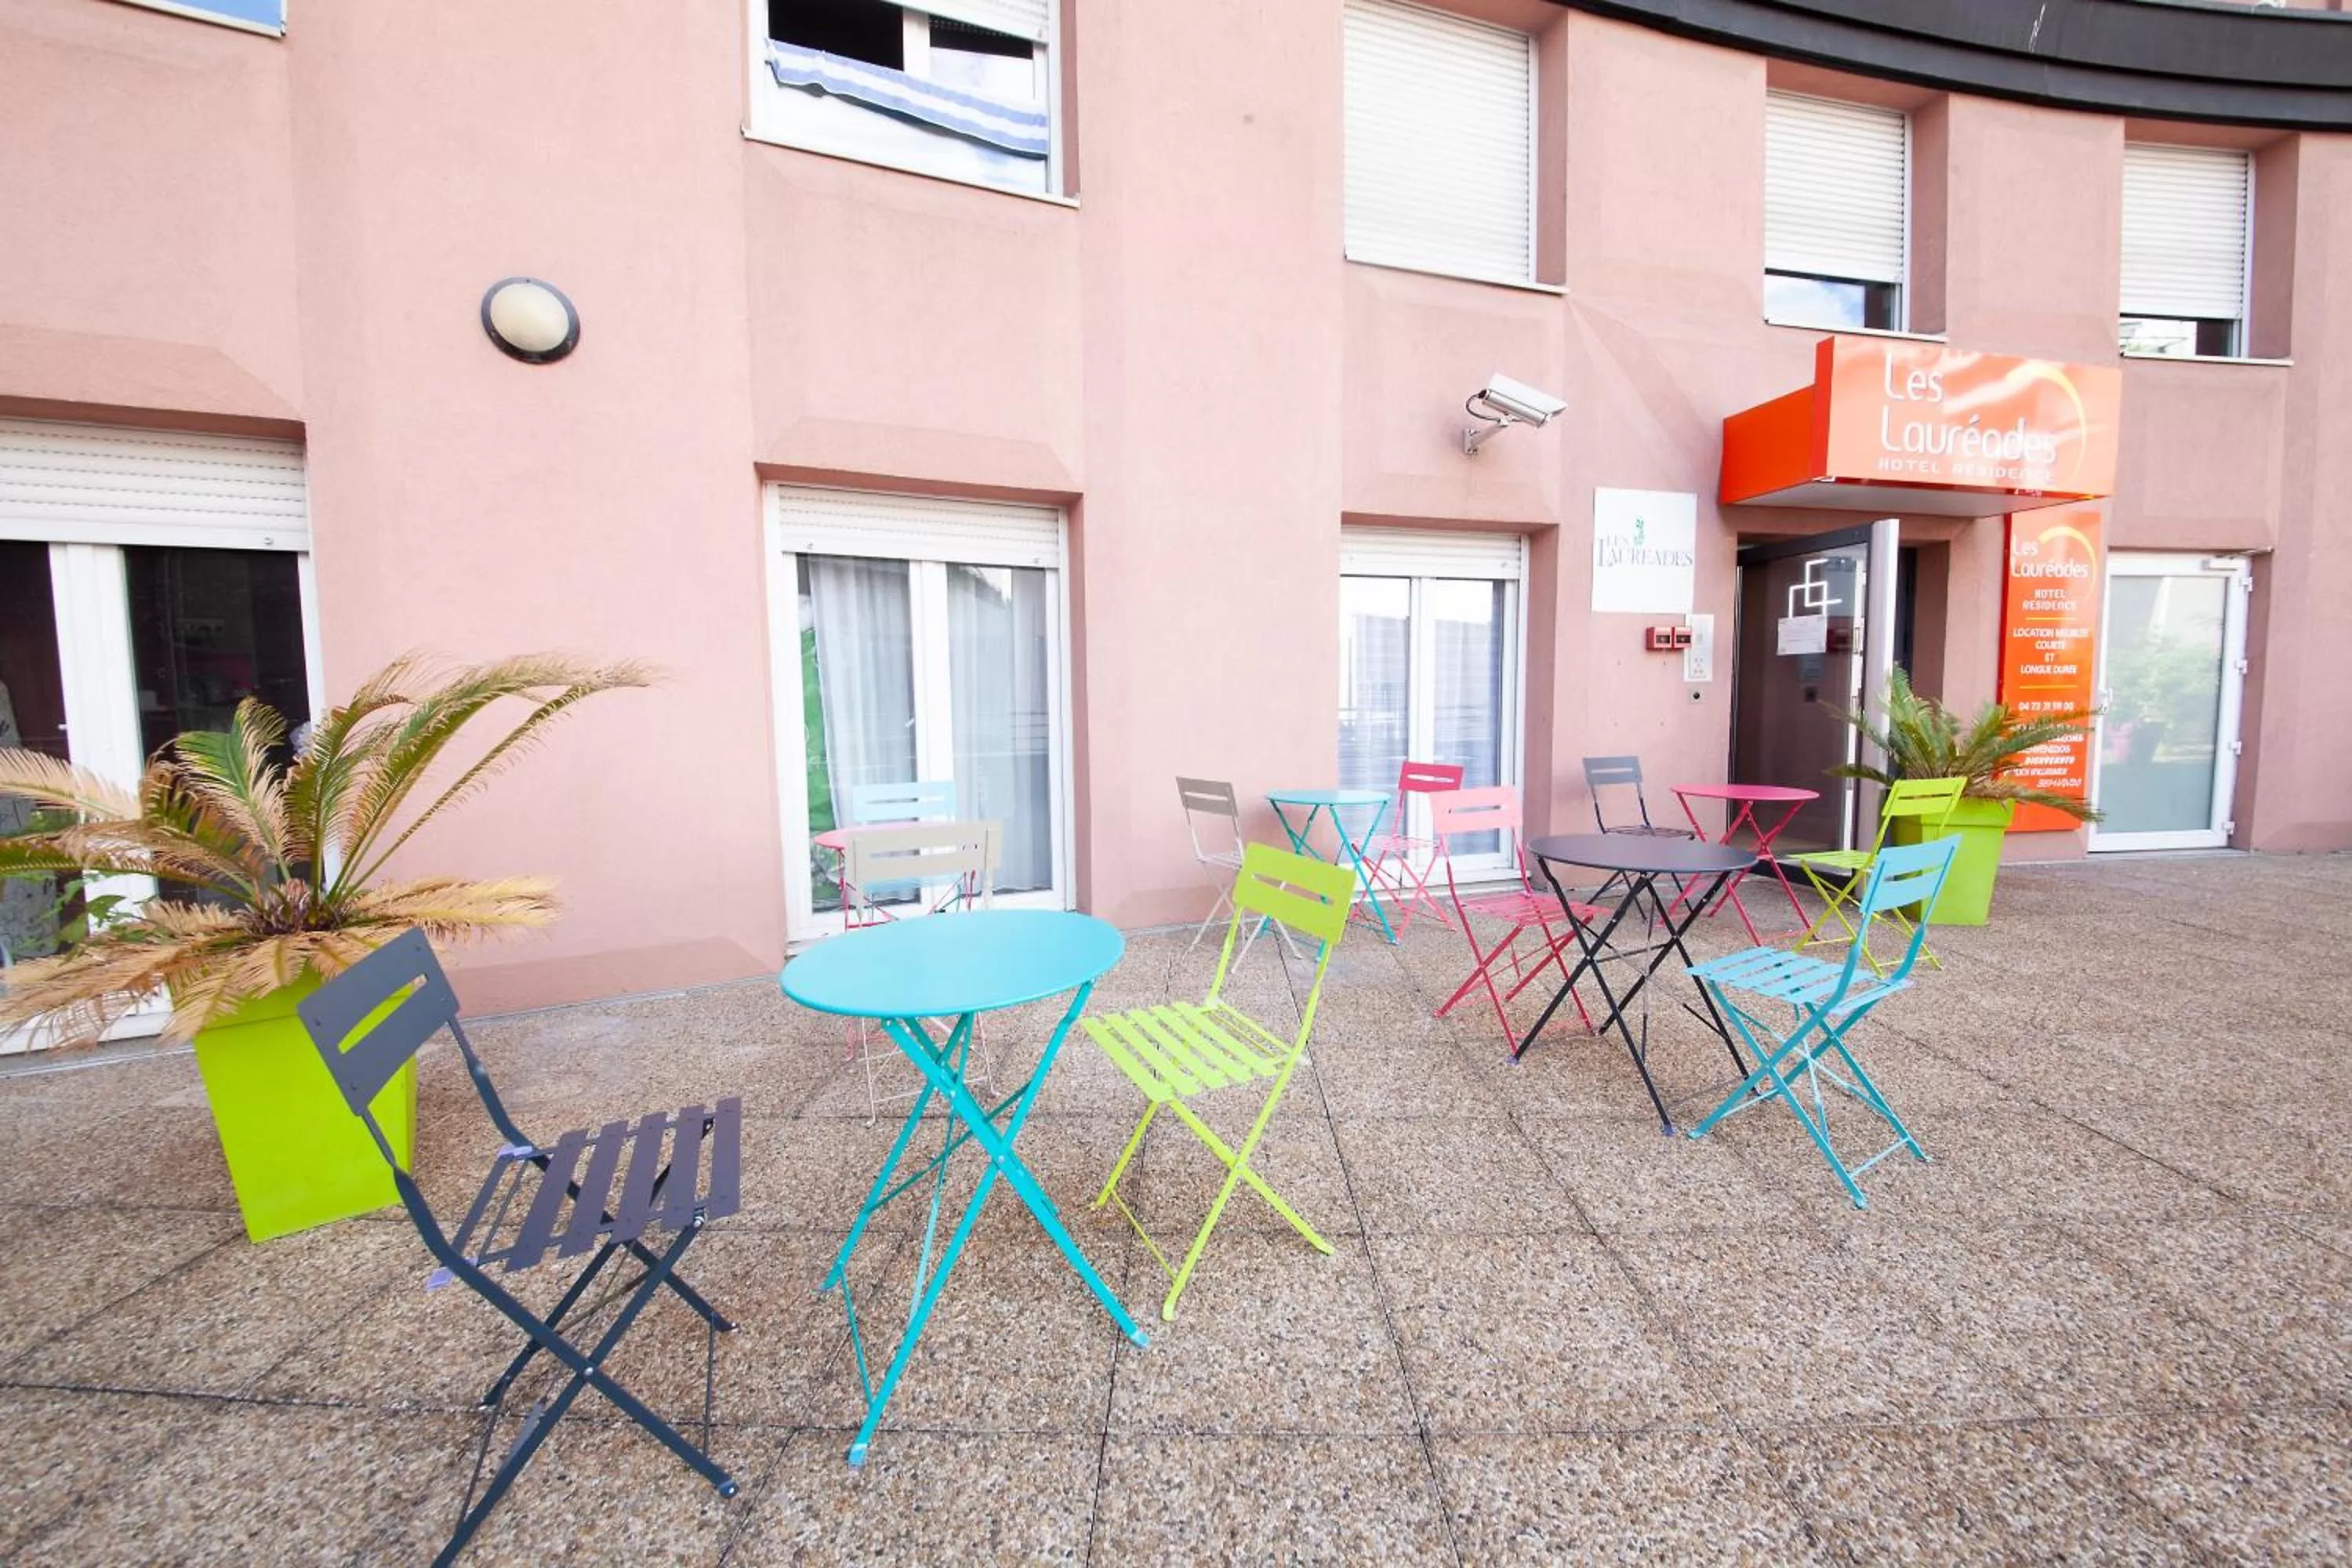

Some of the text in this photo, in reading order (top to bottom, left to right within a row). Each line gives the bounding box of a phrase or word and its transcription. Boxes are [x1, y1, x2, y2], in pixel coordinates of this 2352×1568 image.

[1883, 350, 1944, 402] Les
[1880, 405, 2056, 464] Lauréades
[1878, 457, 1941, 475] HOTEL
[2010, 534, 2038, 556] Les
[2010, 557, 2089, 578] Lauréades
[2034, 589, 2067, 599] HOTEL
[2013, 627, 2054, 637] LOCATION
